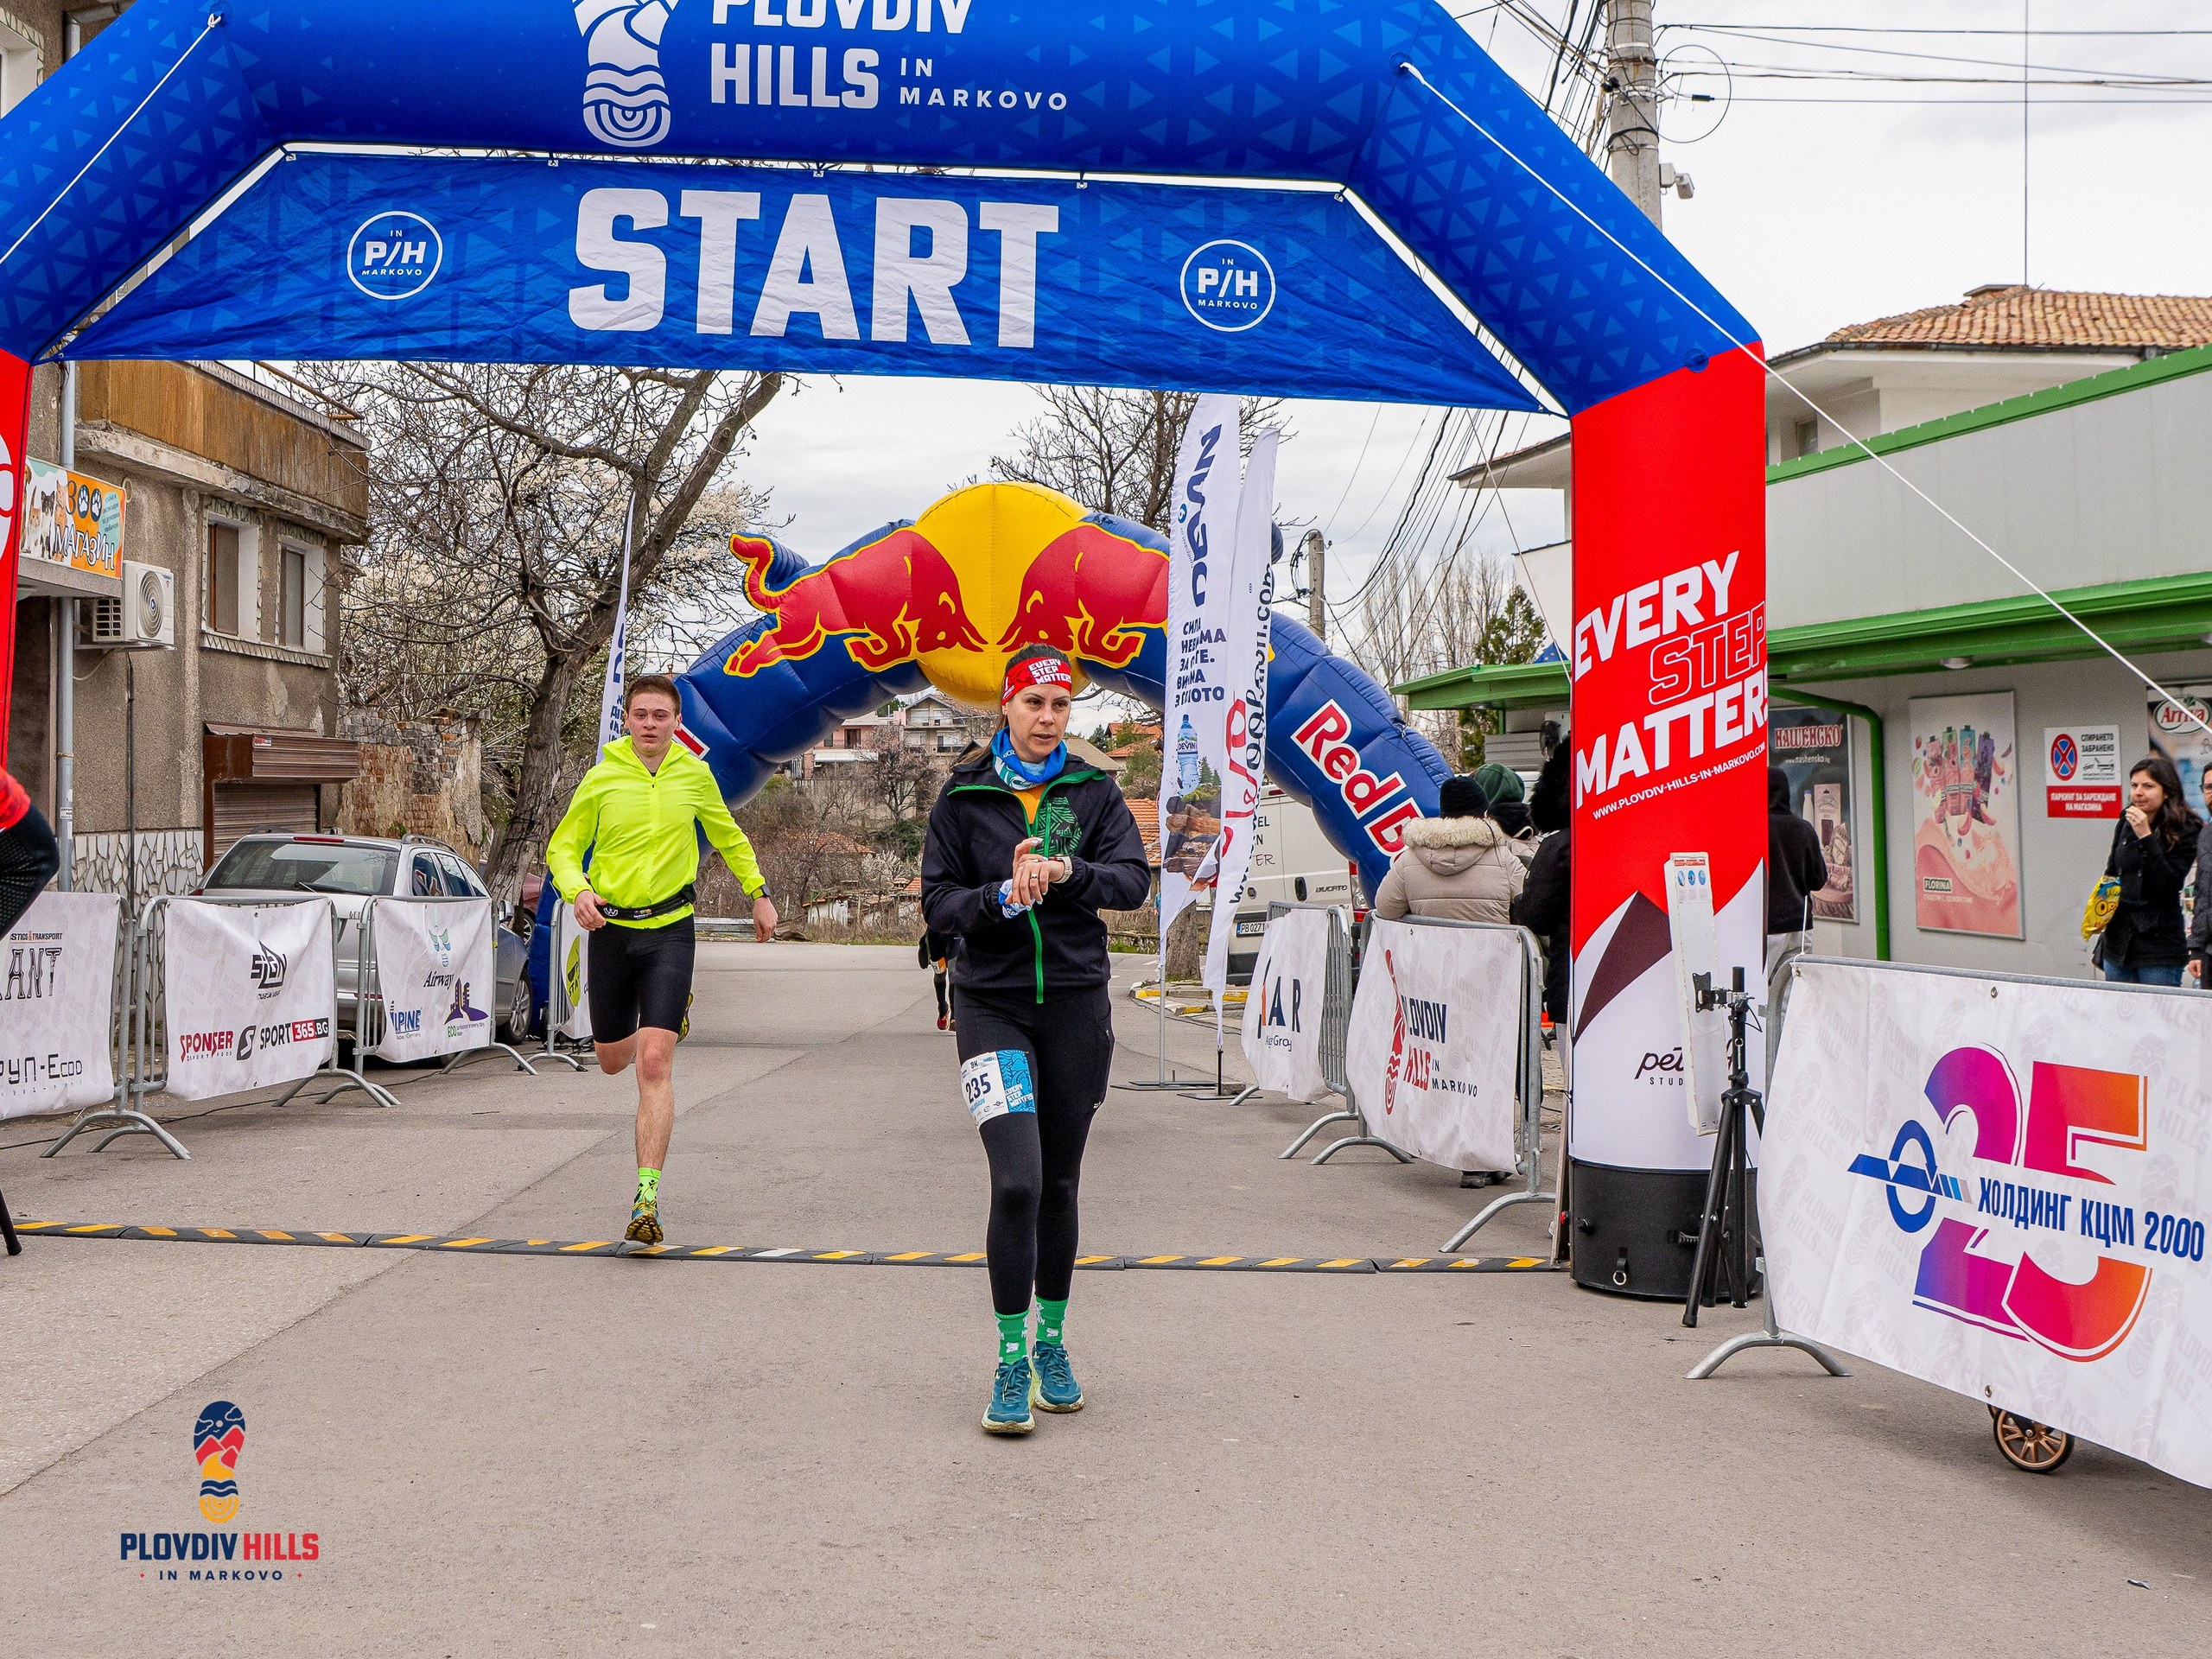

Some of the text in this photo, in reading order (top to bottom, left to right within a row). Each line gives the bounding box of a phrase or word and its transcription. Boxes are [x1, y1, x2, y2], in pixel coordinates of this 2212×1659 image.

[710, 42, 880, 109] HILLS
[899, 57, 933, 79] IN
[899, 86, 1067, 111] MARKOVO
[390, 229, 403, 238] IN
[364, 241, 427, 267] P/H
[1221, 257, 1235, 266] IN
[361, 268, 423, 276] MARKOVO
[569, 188, 1059, 349] START
[1198, 267, 1258, 298] P/H
[1198, 298, 1258, 310] MARKOVO
[54, 524, 116, 571] МАГАЗИН
[1574, 550, 1739, 683] EVERY
[1028, 658, 1061, 671] EVERY
[1648, 600, 1766, 706] STEP
[1031, 665, 1059, 678] STEP
[1178, 741, 1196, 750] DEVIN
[1775, 725, 1842, 749] НАШЕНСКО
[2081, 744, 2114, 753] ЗАБРАНЕНО
[1293, 701, 1405, 817] Red
[423, 970, 455, 990] Airway
[180, 1030, 234, 1063] SPONSER
[1432, 1058, 1440, 1072] IN
[965, 1072, 991, 1104] 235
[1432, 1077, 1478, 1097] MARKOVO
[1978, 1176, 2206, 1263] ХОЛДИНГ КЦМ 2000
